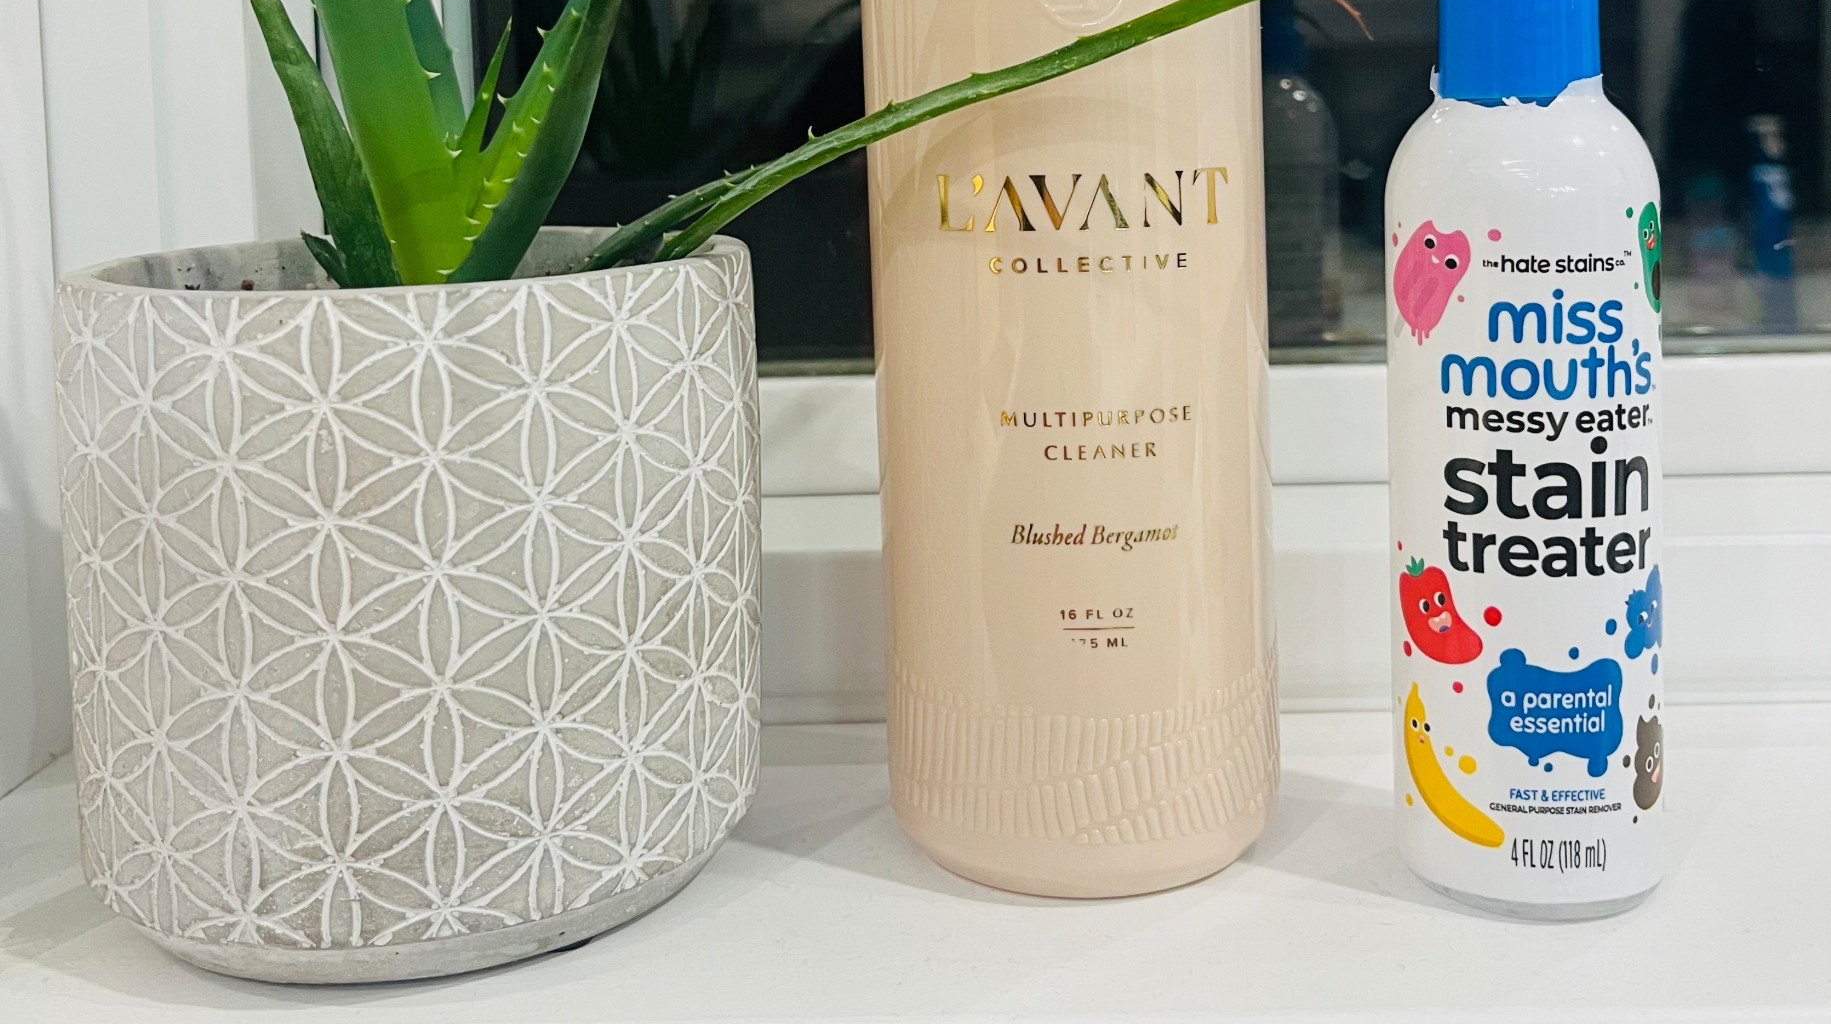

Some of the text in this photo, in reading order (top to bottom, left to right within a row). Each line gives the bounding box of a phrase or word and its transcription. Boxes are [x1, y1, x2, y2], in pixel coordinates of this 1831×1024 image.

[936, 166, 1228, 232] L'AVANT
[988, 252, 1188, 274] COLLECTIVE
[1482, 259, 1499, 268] the
[1500, 255, 1550, 273] hate
[1555, 253, 1614, 273] stains
[1488, 288, 1623, 345] miss
[1441, 338, 1651, 400] mouth's
[1000, 405, 1192, 427] MULTIPURPOSE
[1446, 403, 1650, 442] messy eater
[1043, 442, 1156, 461] CLEANER
[1443, 436, 1649, 520] stain
[1011, 523, 1179, 552] Blushed Bergamot
[1442, 520, 1651, 578] treater
[1060, 607, 1134, 620] 16 FL OZ
[1071, 637, 1128, 649] 75 ML
[1501, 684, 1612, 714] a parental
[1510, 710, 1605, 734] essential
[1509, 788, 1606, 802] FAST & EFFECTIVE
[1489, 802, 1622, 815] GENERAL PURPOSE STAIN REMOVER
[1511, 838, 1607, 873] 4 FL OZ (118 mL)
